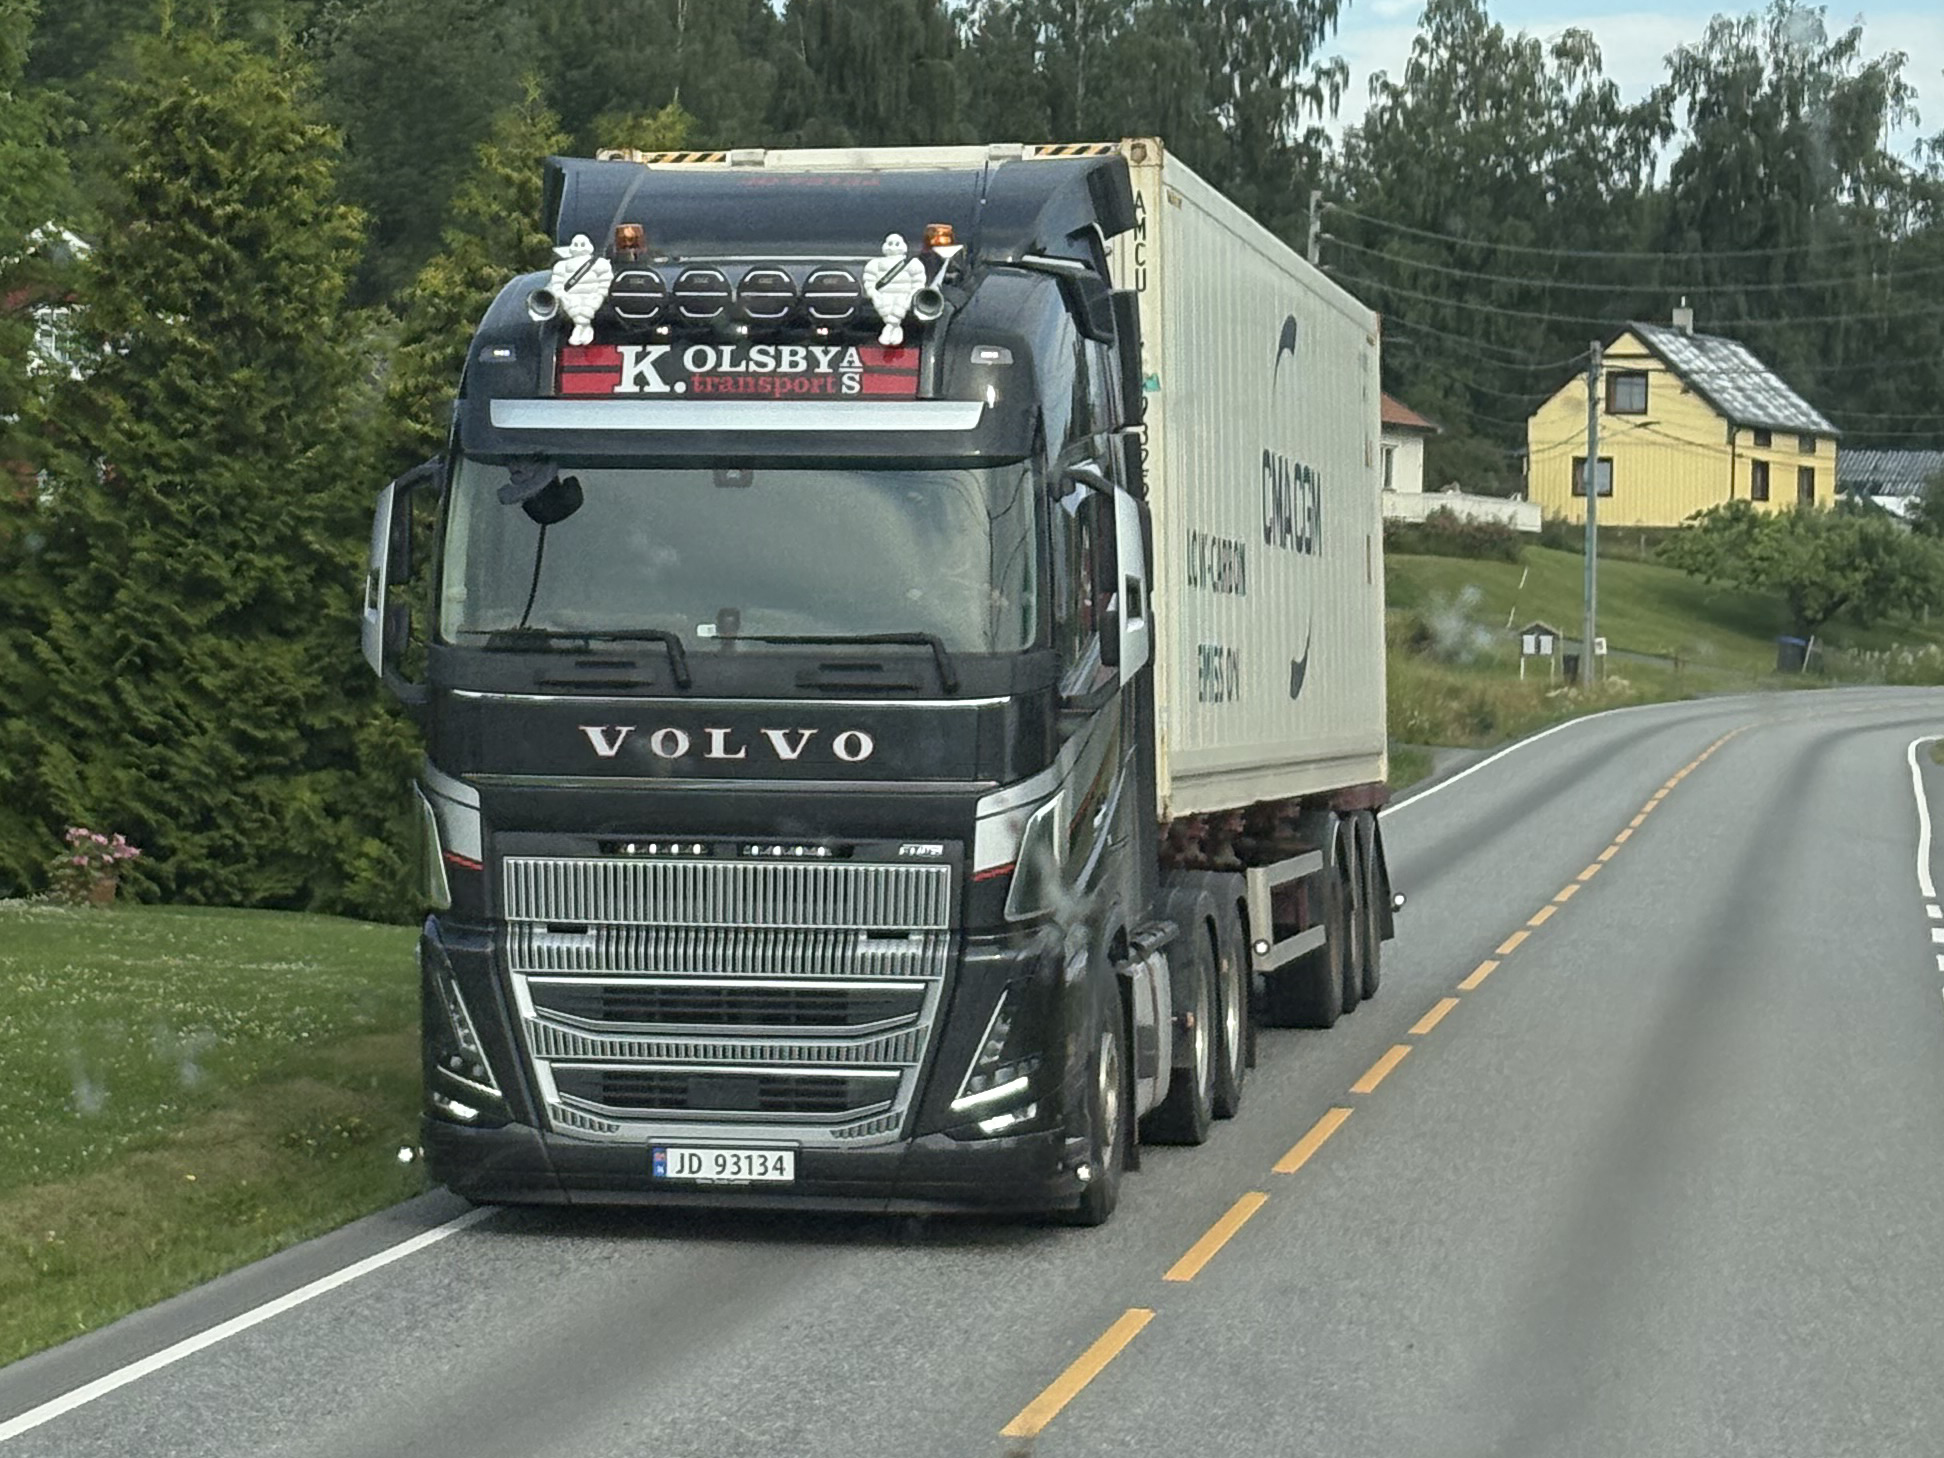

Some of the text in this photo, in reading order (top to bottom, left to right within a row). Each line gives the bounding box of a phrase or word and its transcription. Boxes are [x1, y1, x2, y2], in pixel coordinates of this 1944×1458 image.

[1133, 189, 1147, 293] AMCU
[683, 345, 841, 373] OLSBY
[690, 373, 836, 397] transport
[578, 725, 874, 763] VOLVO
[675, 1153, 786, 1176] JD 93134
